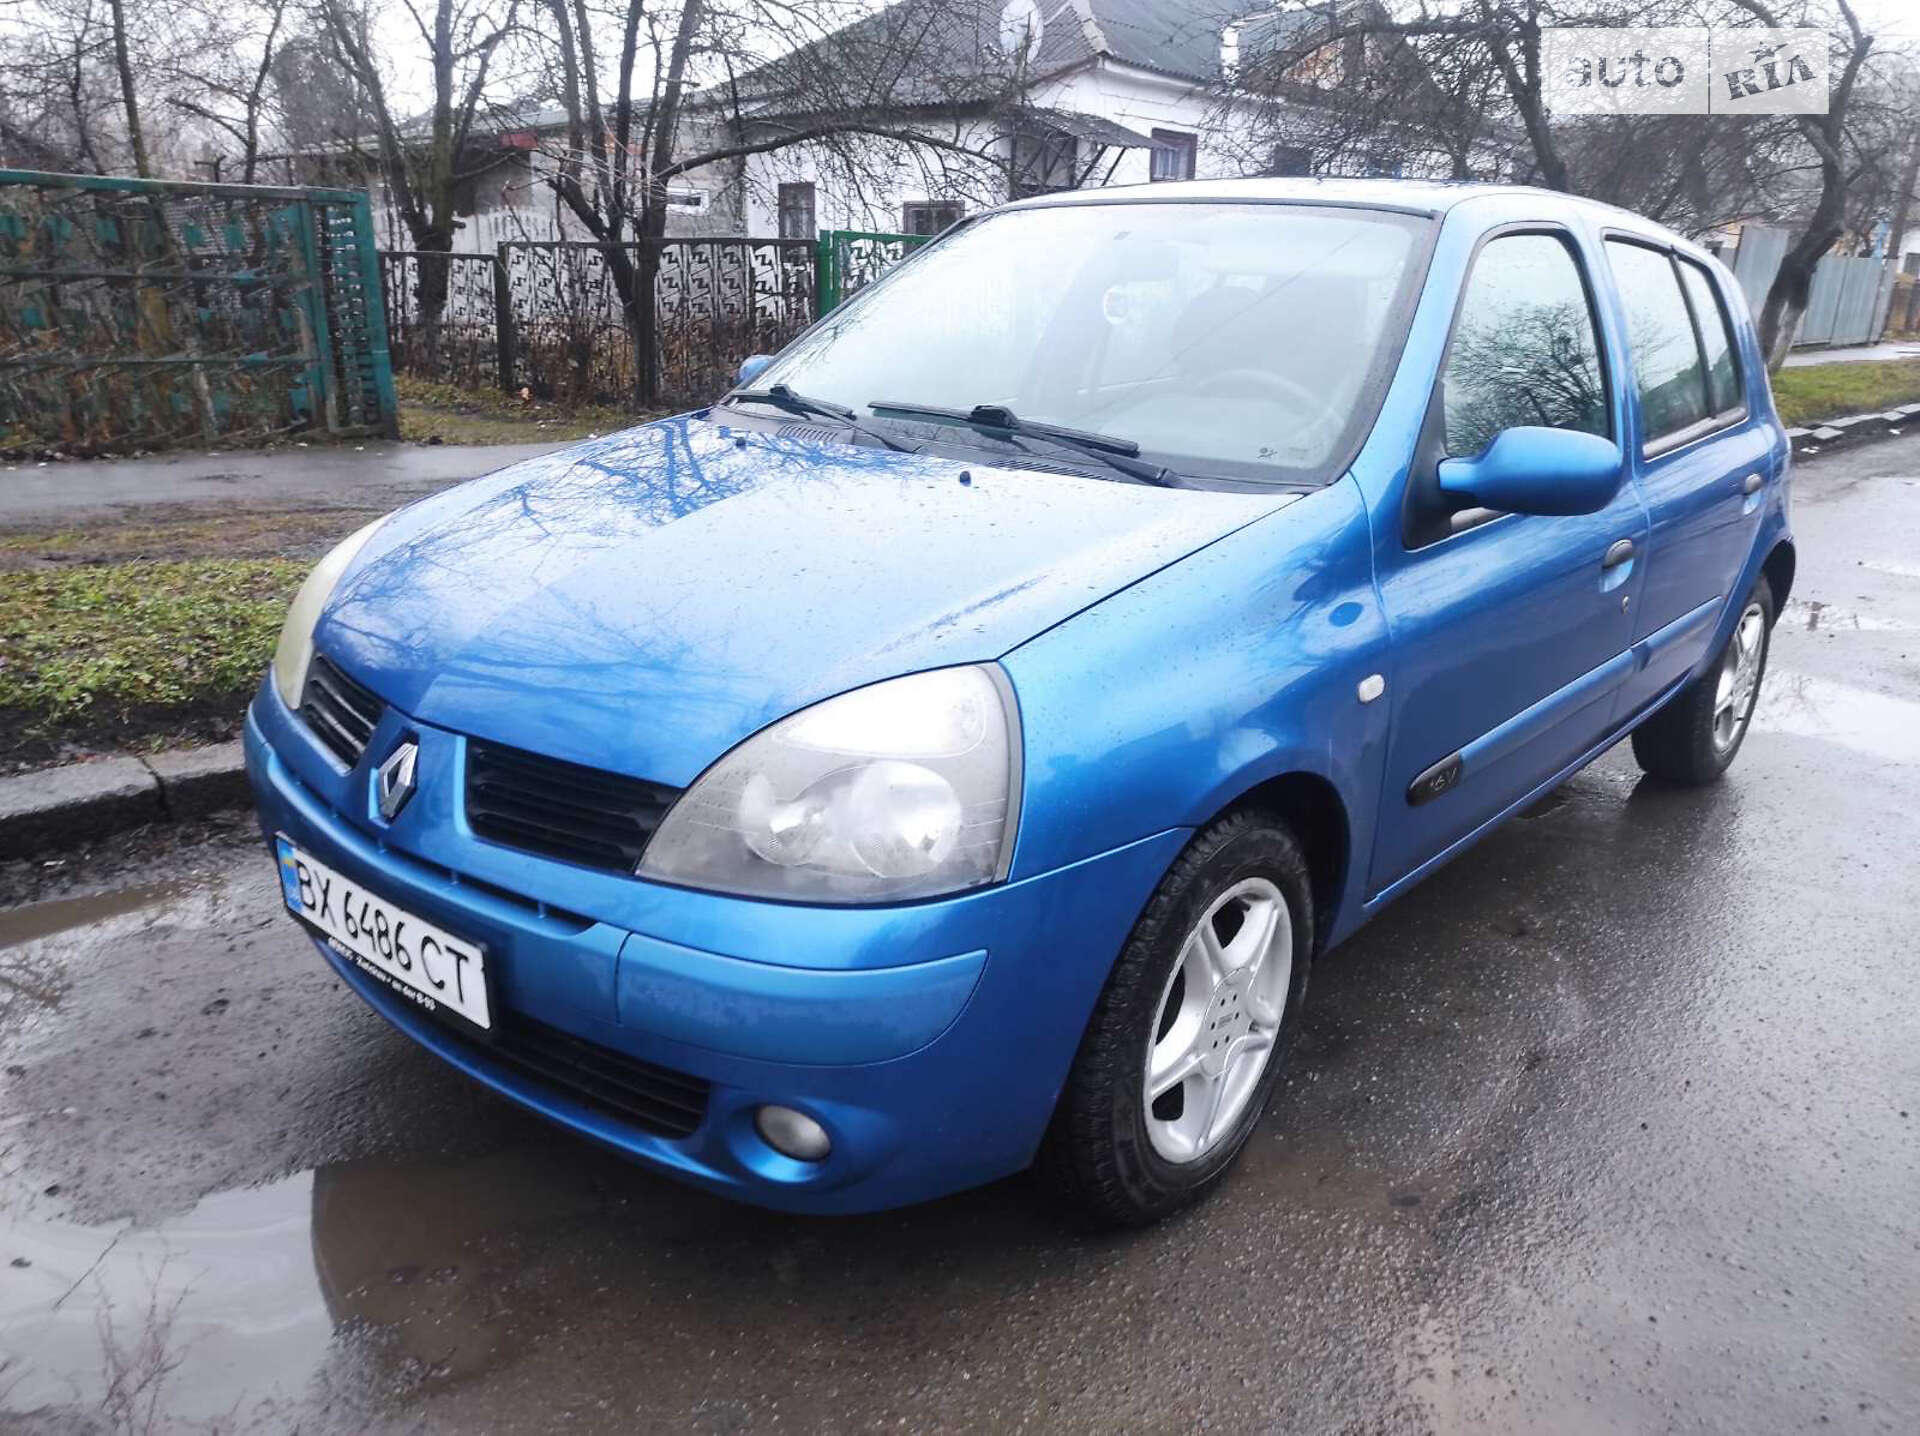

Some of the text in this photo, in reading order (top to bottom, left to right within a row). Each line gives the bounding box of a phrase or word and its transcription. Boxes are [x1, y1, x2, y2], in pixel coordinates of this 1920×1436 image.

[296, 860, 337, 928] BX
[344, 891, 412, 971] 6486
[421, 935, 470, 1005] CT
